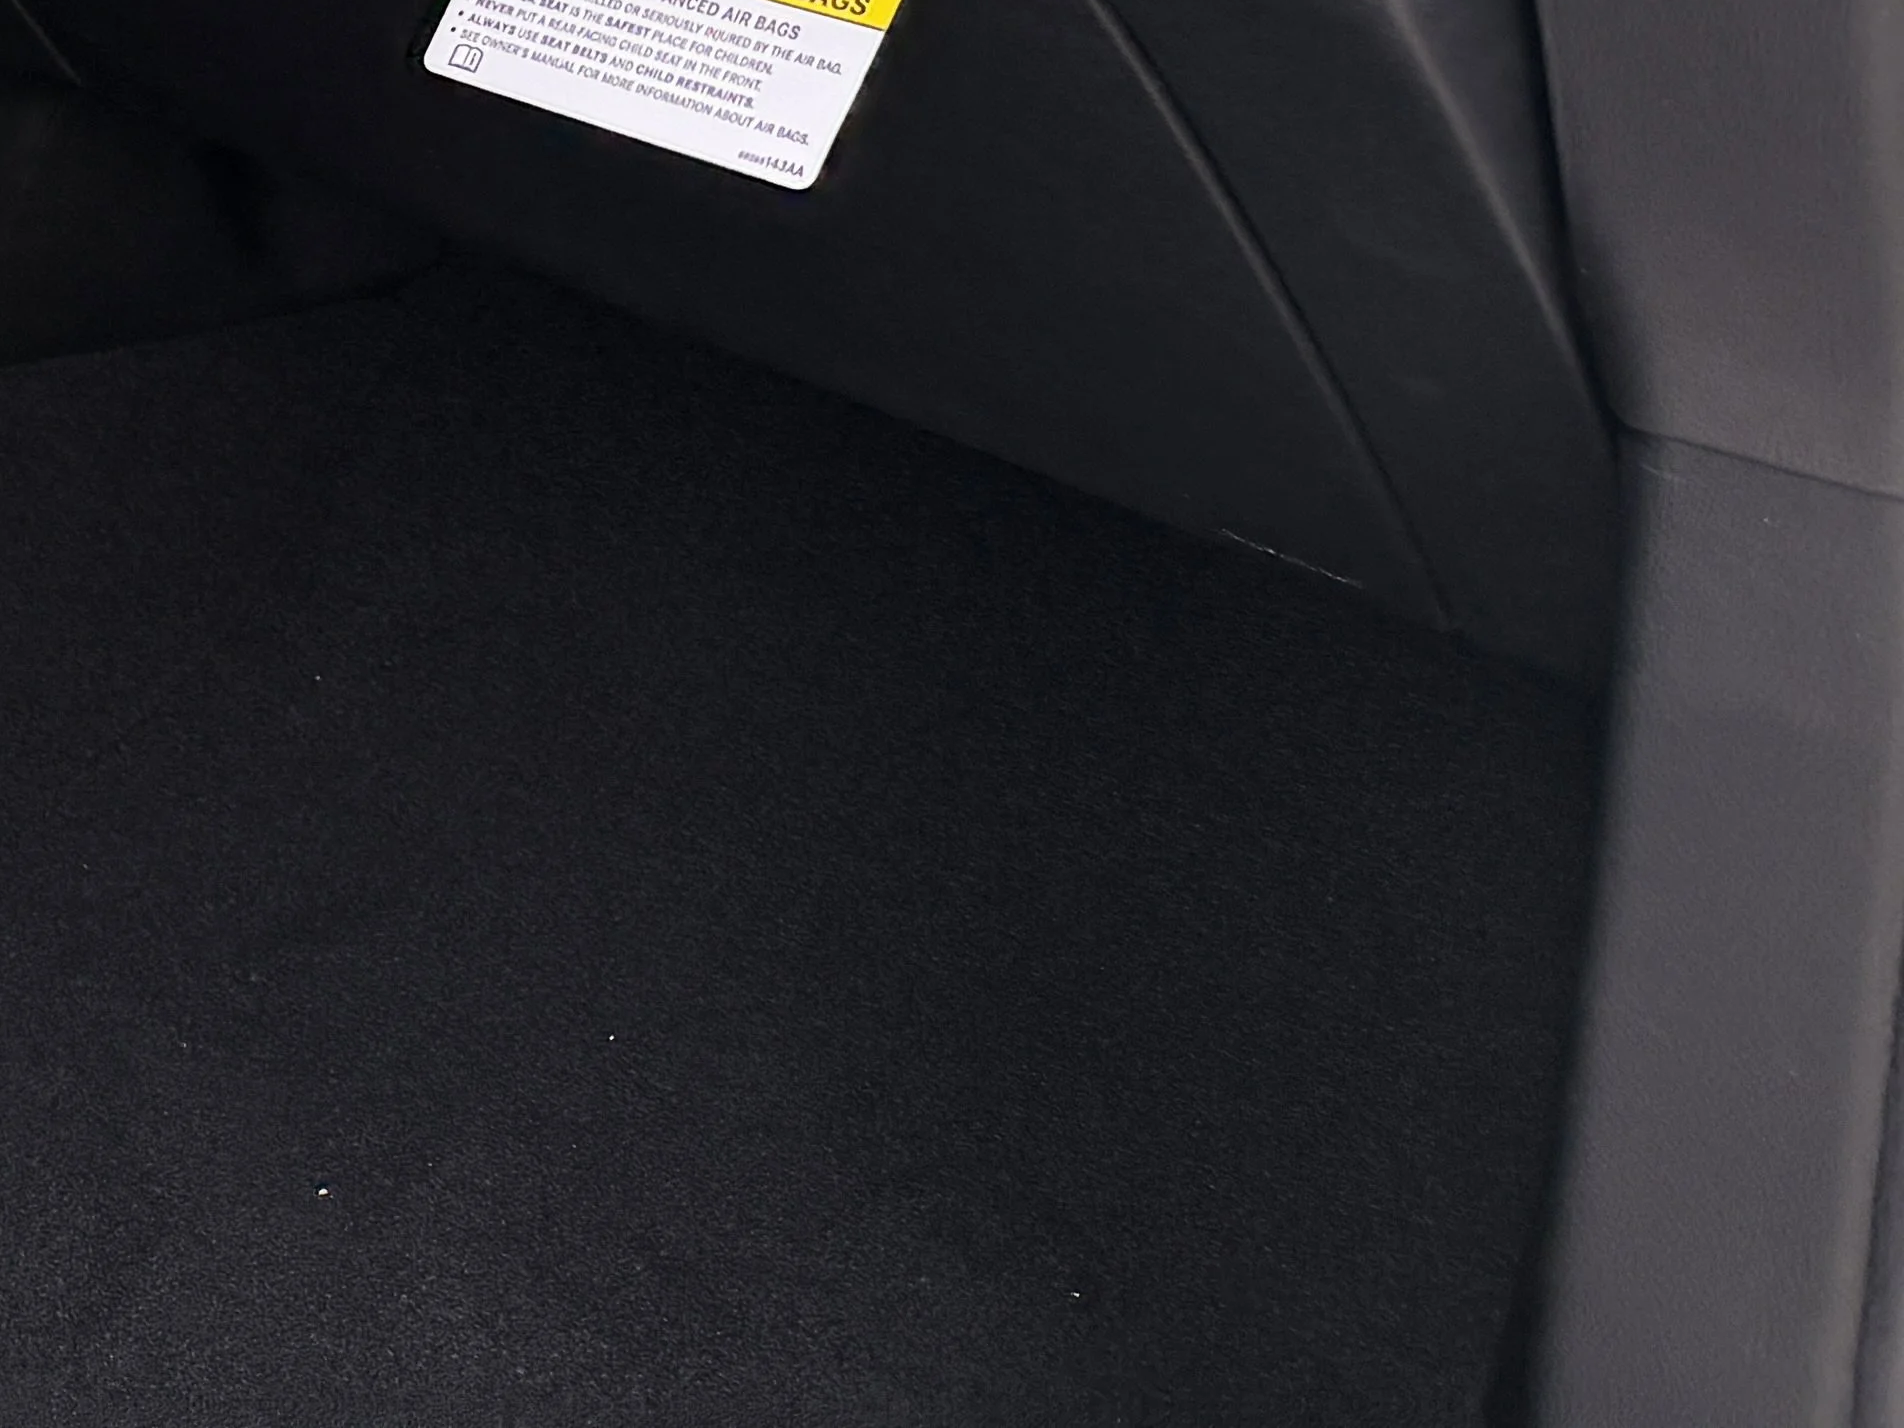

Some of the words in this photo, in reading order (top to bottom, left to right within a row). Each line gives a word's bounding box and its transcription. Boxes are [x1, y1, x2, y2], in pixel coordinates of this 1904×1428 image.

[467, 13, 517, 36] ALWAYS
[517, 28, 540, 43] USE
[540, 34, 572, 52] SEAT
[571, 44, 608, 64] BELTS
[608, 55, 634, 72] AND
[635, 63, 675, 84] CHILD
[515, 8, 538, 23] PUT
[536, 15, 546, 26] A
[618, 39, 654, 58] CHILD
[654, 50, 683, 67] SEAT
[682, 59, 698, 72] IN
[698, 62, 722, 79] THE
[568, 6, 581, 18] IS
[582, 8, 605, 25] THE
[604, 16, 651, 38] SAFEST
[650, 29, 688, 50] PLACE
[688, 40, 713, 57] FOR
[623, 2, 641, 16] OR
[641, 8, 704, 34] SERIOUSLY
[752, 40, 770, 54] BY
[771, 45, 795, 61] THE
[793, 52, 815, 67] AIR
[721, 6, 752, 27] AIR
[754, 15, 801, 40] BAGS
[459, 28, 481, 43] SEE
[530, 51, 575, 74] MANUAL
[576, 64, 601, 80] FOR
[601, 72, 635, 92] MORE
[635, 83, 713, 115] INFORMATION
[713, 107, 755, 128] ABOUT
[753, 120, 775, 135] AIR
